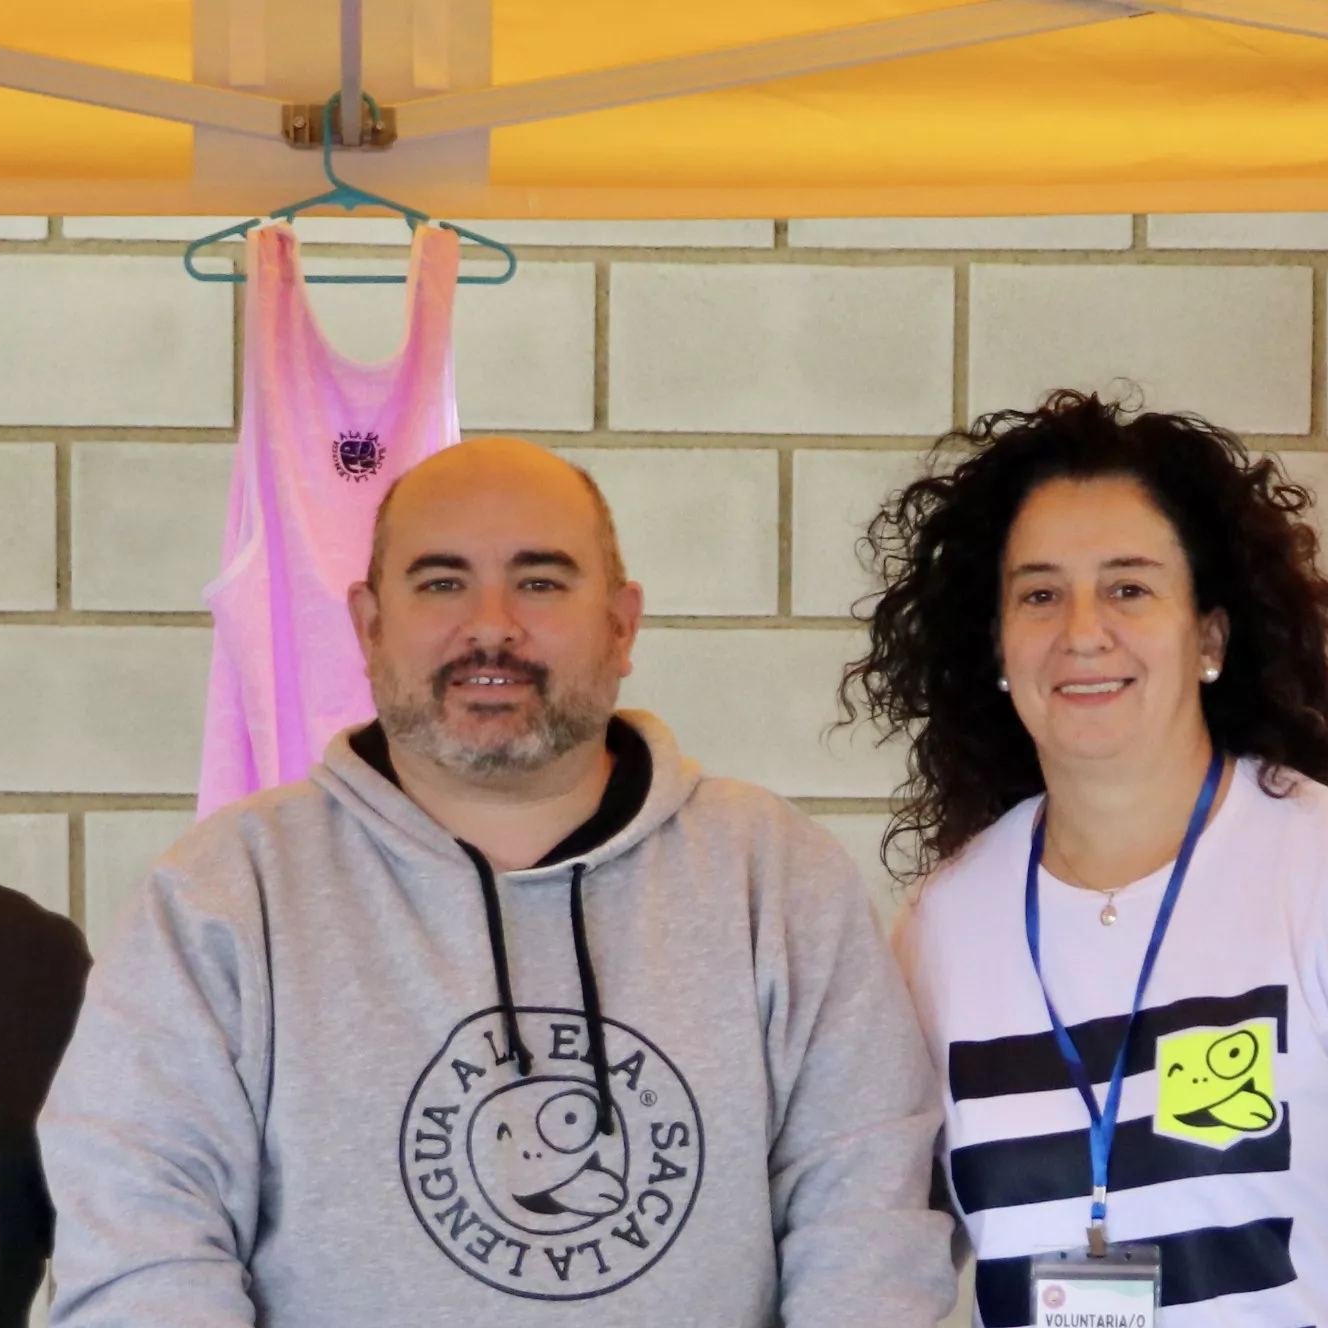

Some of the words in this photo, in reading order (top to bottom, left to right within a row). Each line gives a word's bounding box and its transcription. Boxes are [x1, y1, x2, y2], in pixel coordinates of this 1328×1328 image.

[451, 1058, 486, 1093] A
[548, 1023, 646, 1091] EA
[415, 1103, 531, 1277] LENGUA
[611, 1121, 690, 1249] SACA
[544, 1238, 611, 1281] LA
[1045, 1313, 1146, 1328] VOLUNTARIA/O
